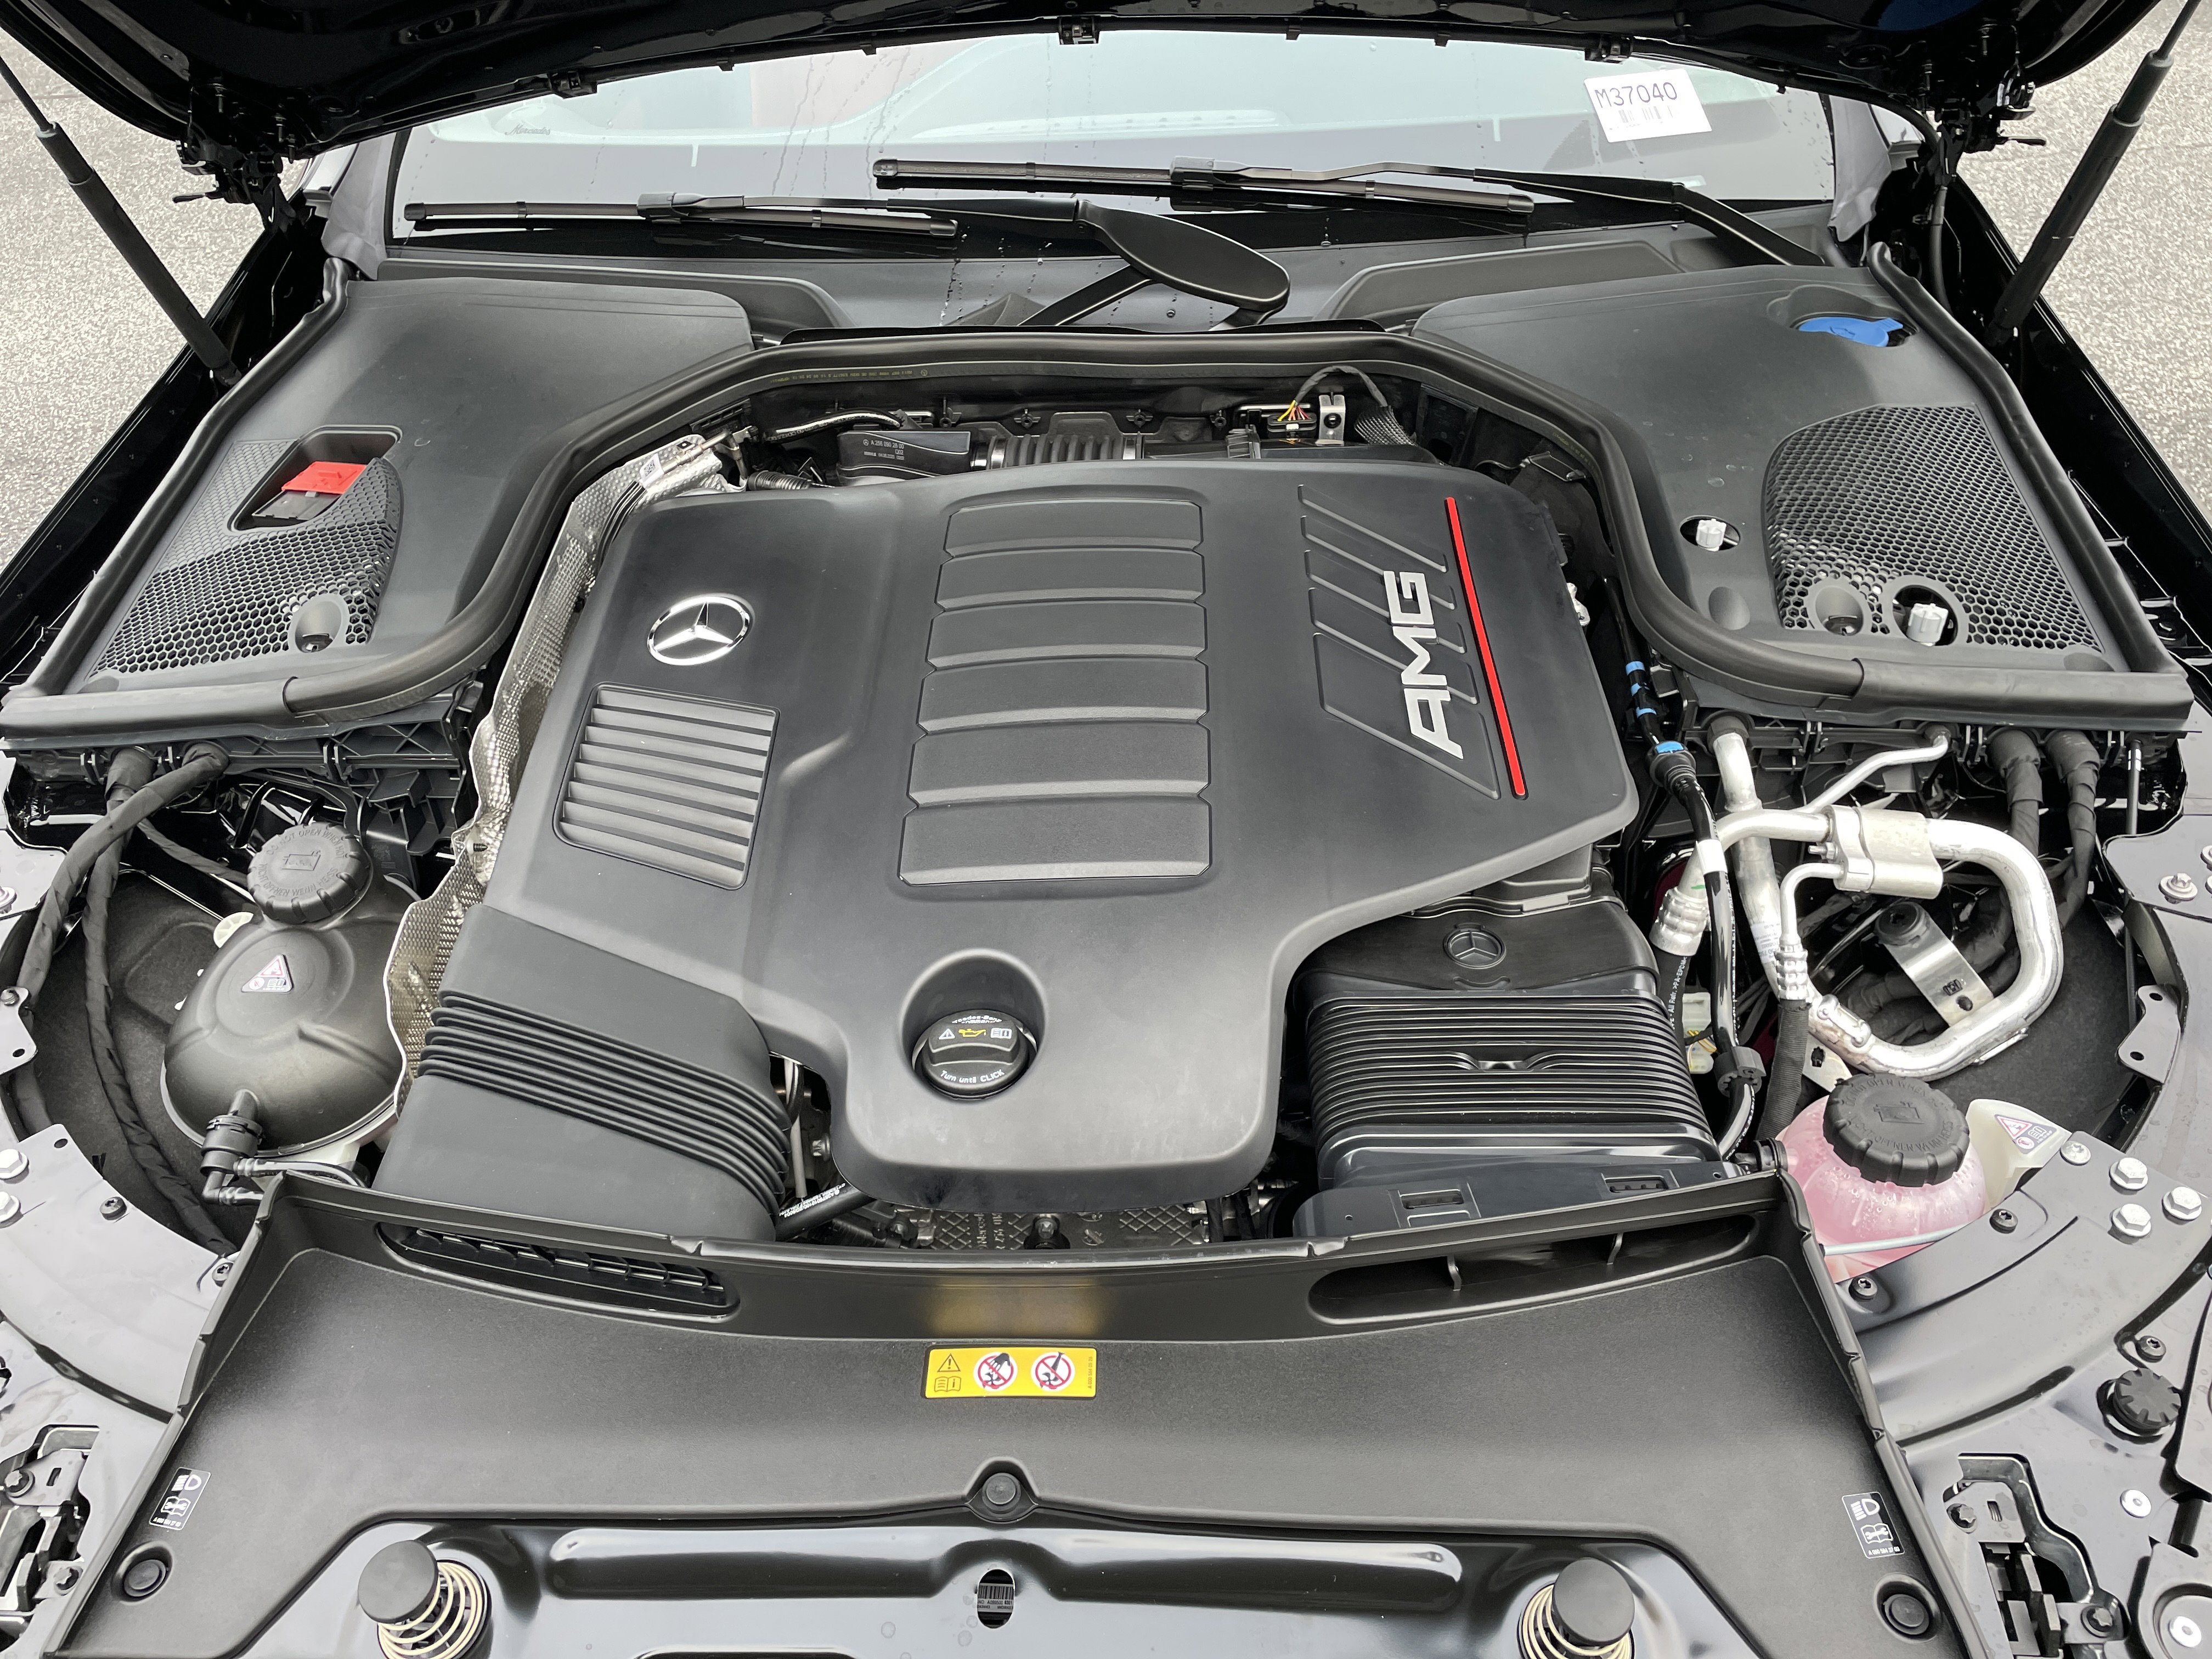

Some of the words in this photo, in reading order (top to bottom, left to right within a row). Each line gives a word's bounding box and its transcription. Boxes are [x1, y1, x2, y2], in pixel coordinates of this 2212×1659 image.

[1594, 82, 1678, 109] M37040
[1384, 571, 1463, 759] AMG
[280, 834, 295, 846] NOT
[298, 829, 321, 837] OPEN
[323, 831, 342, 847] WHEN
[292, 883, 317, 896] WENN
[940, 1070, 957, 1082] Turn
[980, 1069, 1005, 1082] CLICK
